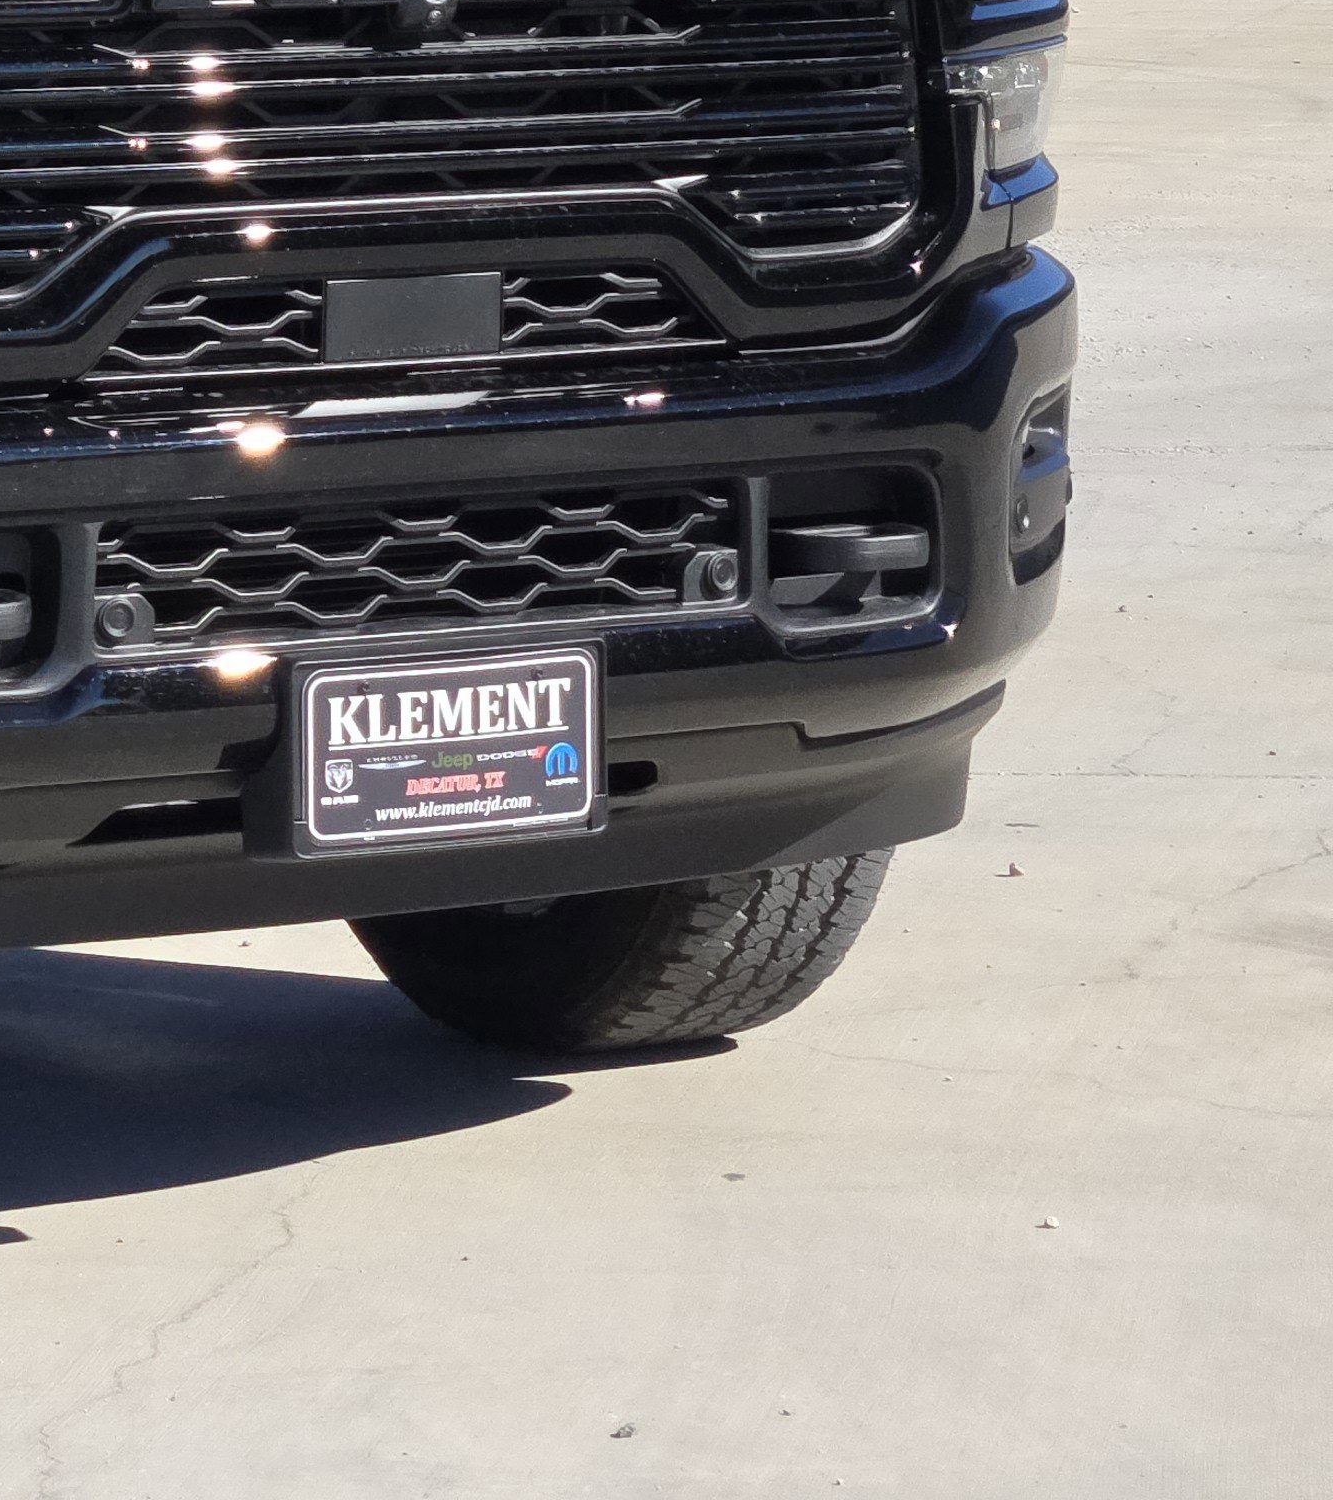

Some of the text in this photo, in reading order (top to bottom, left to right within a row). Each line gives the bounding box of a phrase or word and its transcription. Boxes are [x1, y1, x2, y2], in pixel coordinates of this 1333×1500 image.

[327, 677, 572, 746] KLEMENT
[432, 751, 474, 771] Jeep
[484, 770, 506, 789] TX
[374, 794, 532, 822] www.klementcjd.com
